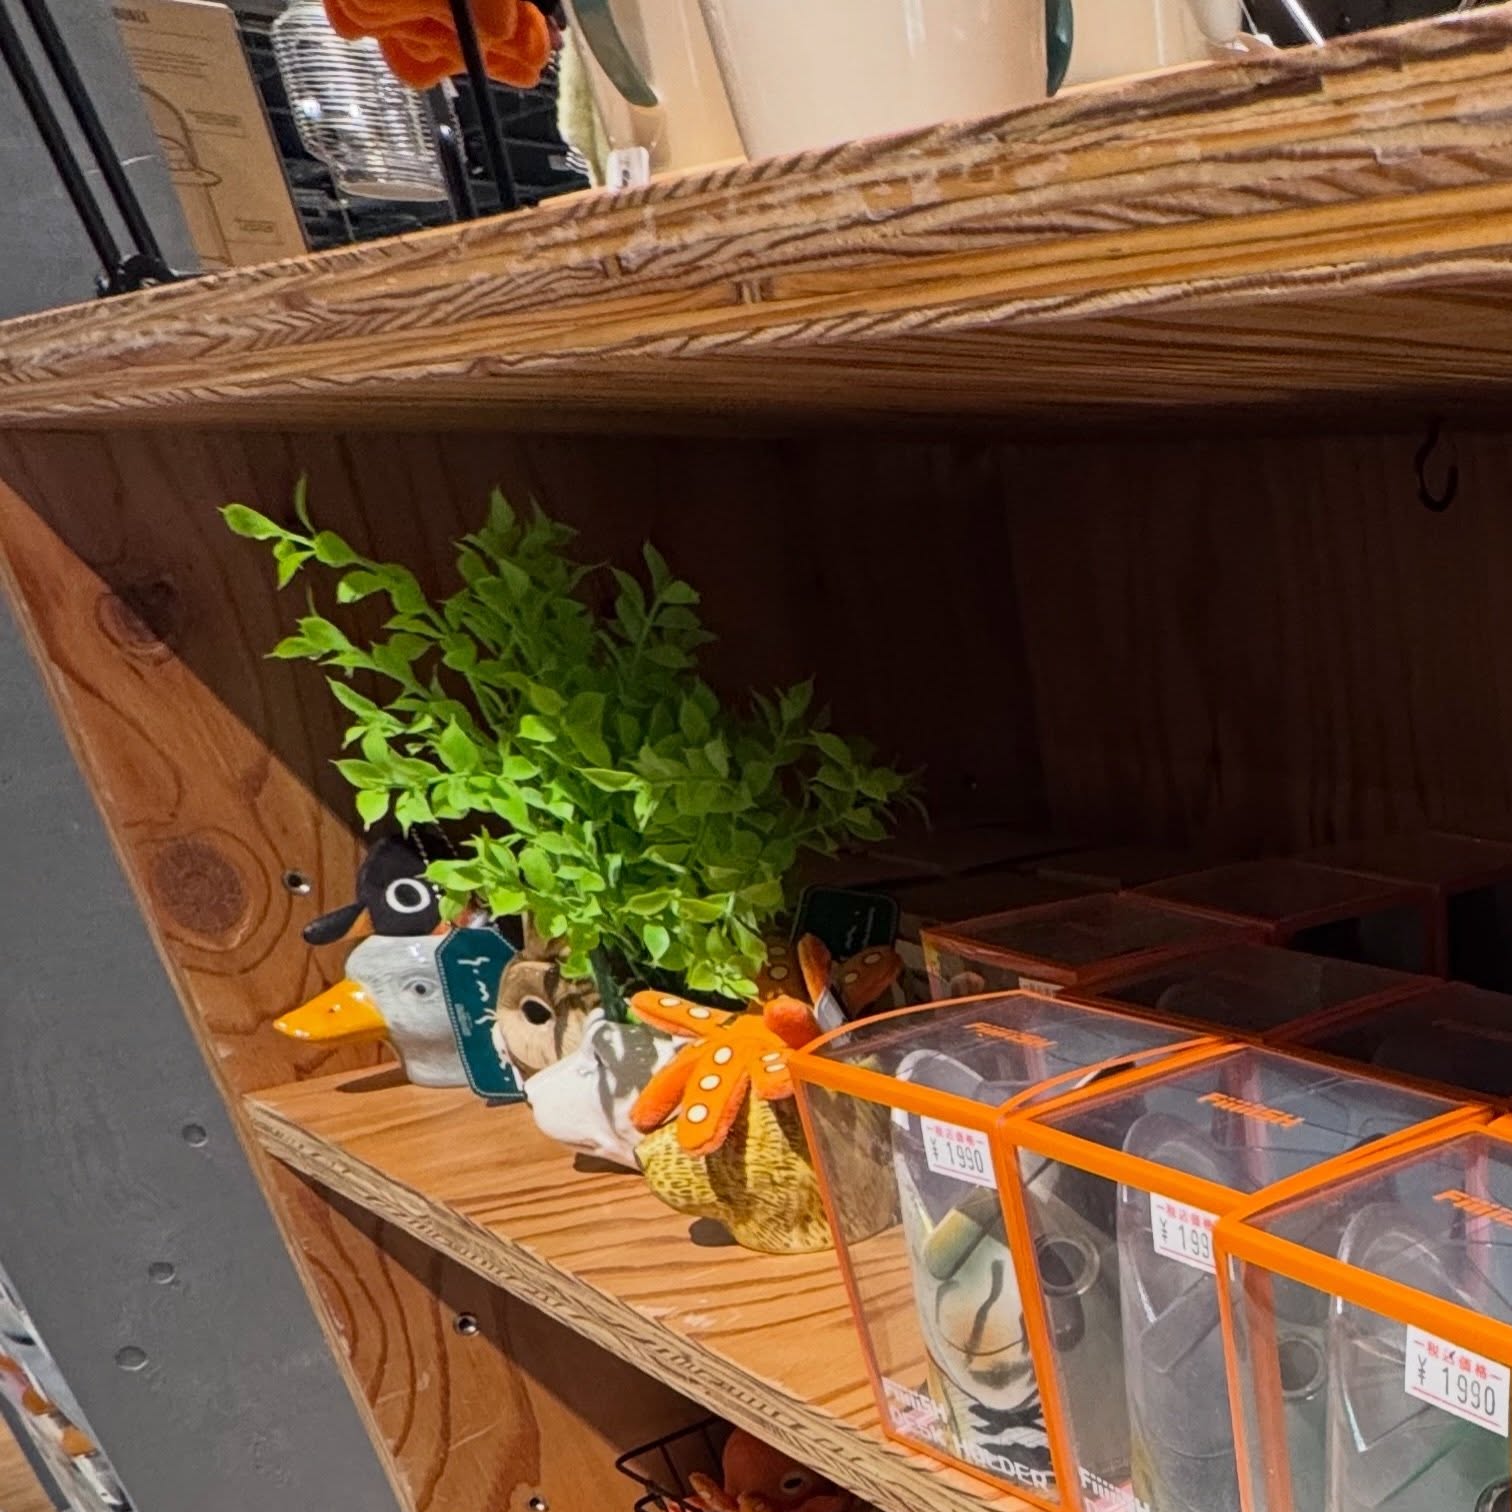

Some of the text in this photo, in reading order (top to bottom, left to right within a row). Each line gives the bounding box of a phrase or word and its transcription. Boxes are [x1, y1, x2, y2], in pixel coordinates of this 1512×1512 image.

[946, 1141, 984, 1174] 1990
[1178, 1225, 1210, 1259] 199
[1442, 1367, 1496, 1417] 1990
